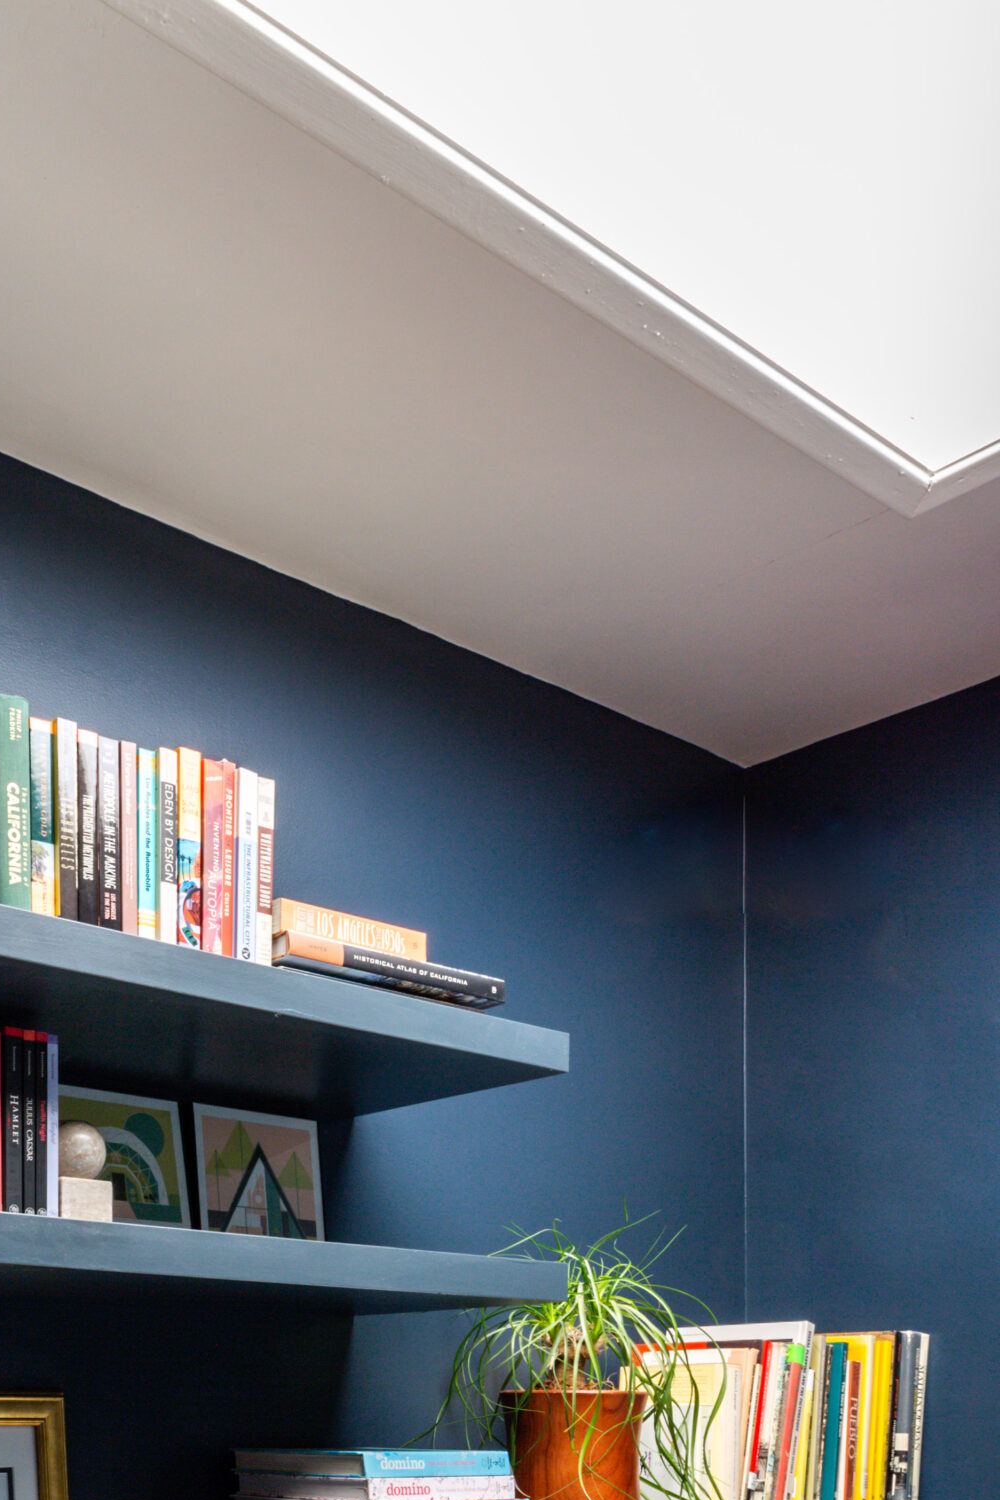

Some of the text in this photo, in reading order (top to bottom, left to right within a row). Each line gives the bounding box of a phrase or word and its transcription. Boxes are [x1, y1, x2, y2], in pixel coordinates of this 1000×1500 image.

[6, 781, 21, 886] CALIFORNIA
[40, 809, 48, 838] GOLD
[104, 770, 117, 890] METROPOLIS IN THE MAKING
[164, 783, 174, 883] EDEN BY DESIGN
[224, 788, 233, 886] FRONTIER LEISURE
[144, 850, 152, 892] Automobile
[207, 821, 221, 931] INVENTING AUTOPIA
[316, 911, 334, 939] LOS
[336, 917, 376, 949] ANGELES
[381, 929, 406, 954] 1930s
[353, 953, 468, 986] HISTORICAL ATLAS OF CALIFORNIA
[9, 1094, 20, 1145] HAMLET
[25, 1096, 35, 1162] JULIUS CAESAR
[848, 1397, 859, 1460] PUEBLO
[380, 1456, 426, 1471] domino
[386, 1482, 432, 1497] domino
